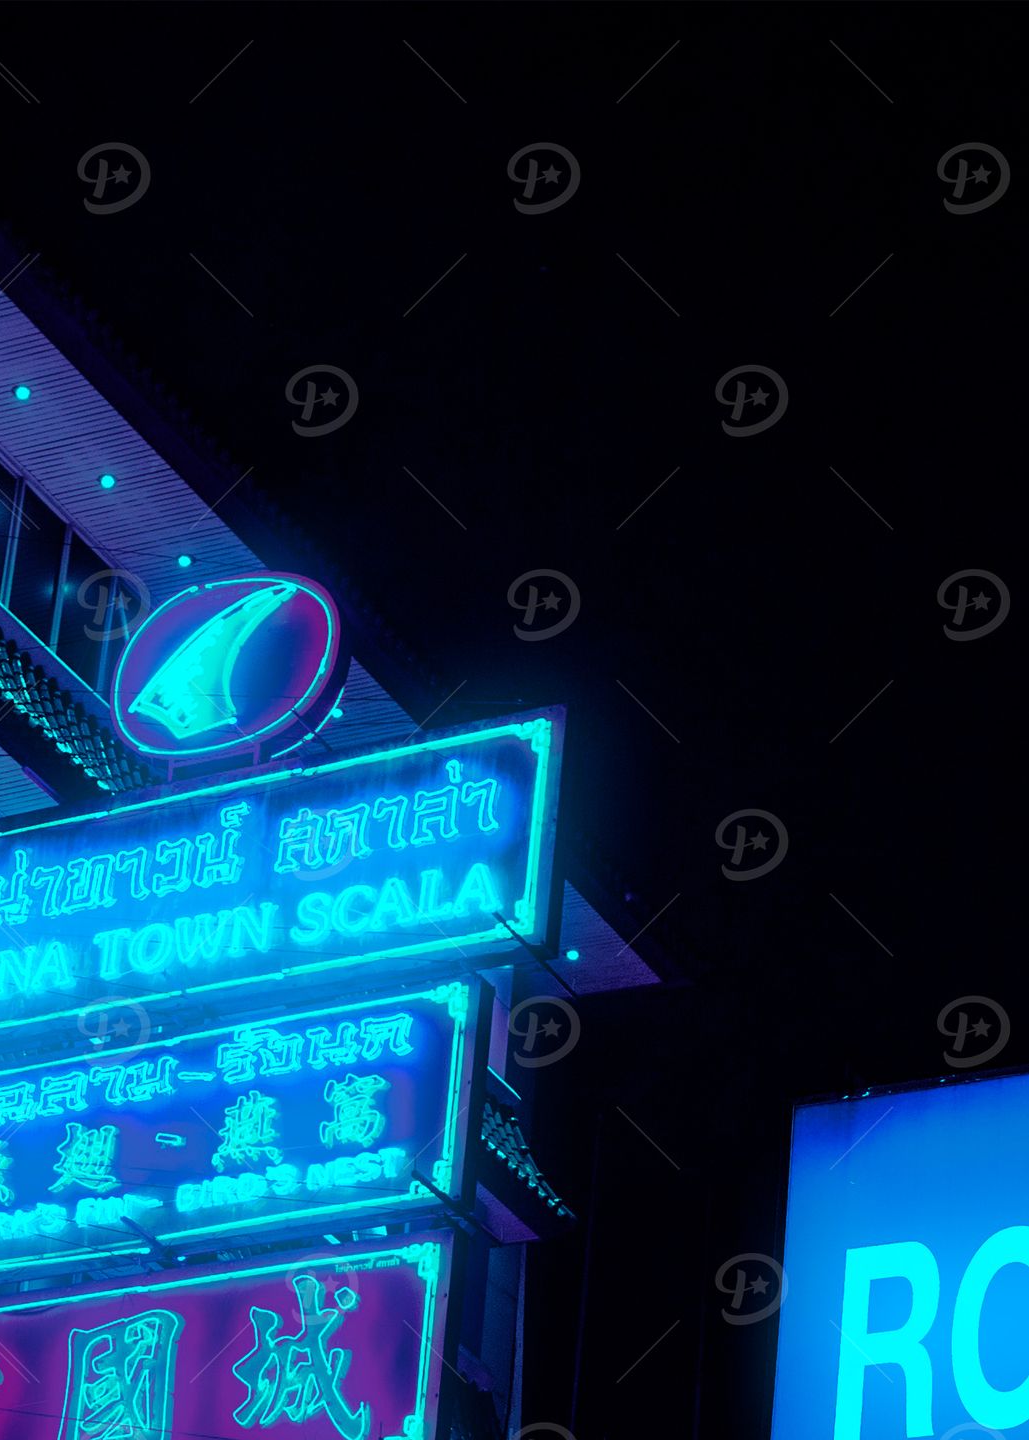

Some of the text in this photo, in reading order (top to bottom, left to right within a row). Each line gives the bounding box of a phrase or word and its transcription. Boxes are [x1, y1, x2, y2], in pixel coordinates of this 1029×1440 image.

[276, 760, 501, 872] สกาล่า
[95, 902, 273, 979] TOWN
[289, 862, 503, 947] SCALA
[306, 1147, 406, 1191] NEST
